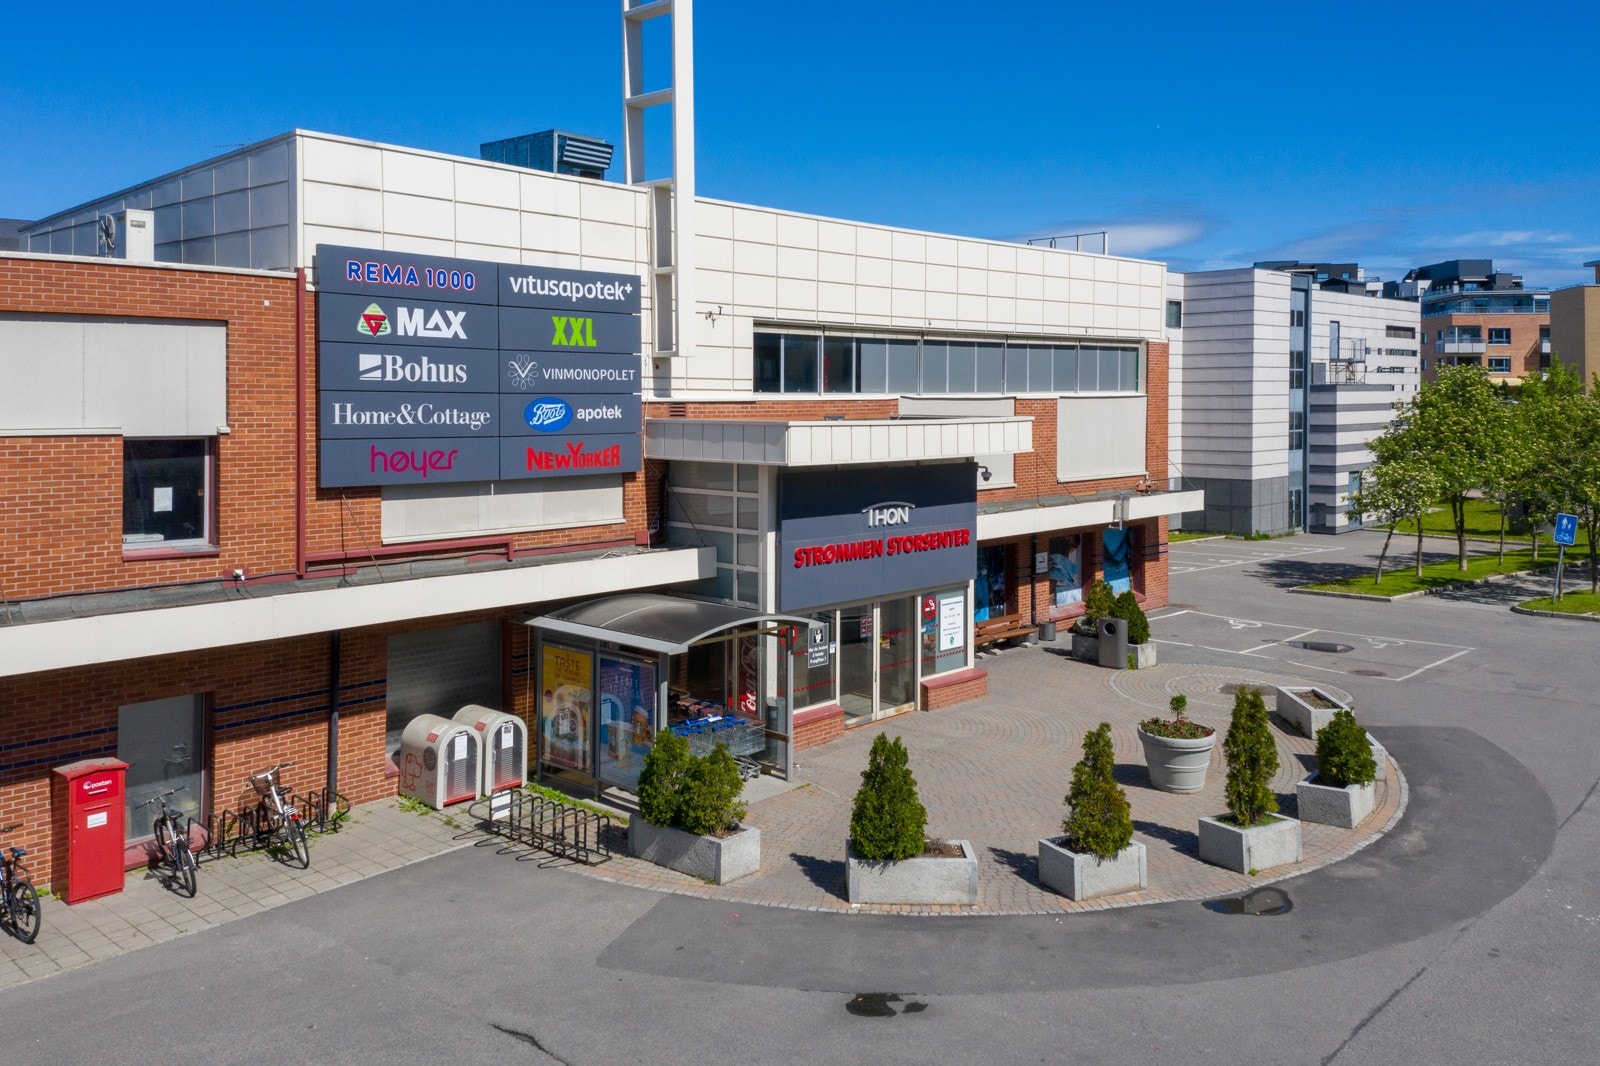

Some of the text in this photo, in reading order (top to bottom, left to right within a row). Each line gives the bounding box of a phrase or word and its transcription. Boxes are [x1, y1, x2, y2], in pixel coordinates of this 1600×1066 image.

[346, 259, 477, 291] REMA 1000
[397, 306, 468, 340] MAX
[551, 315, 597, 347] XXL
[384, 355, 467, 384] Bohus
[542, 367, 636, 381] VINMONOPOLET
[332, 403, 491, 430] Home&Cottage
[530, 403, 622, 425] Boots apotek
[862, 501, 916, 527] THON
[794, 529, 970, 567] STRØMMEN STORSENTER
[91, 780, 112, 788] posten
